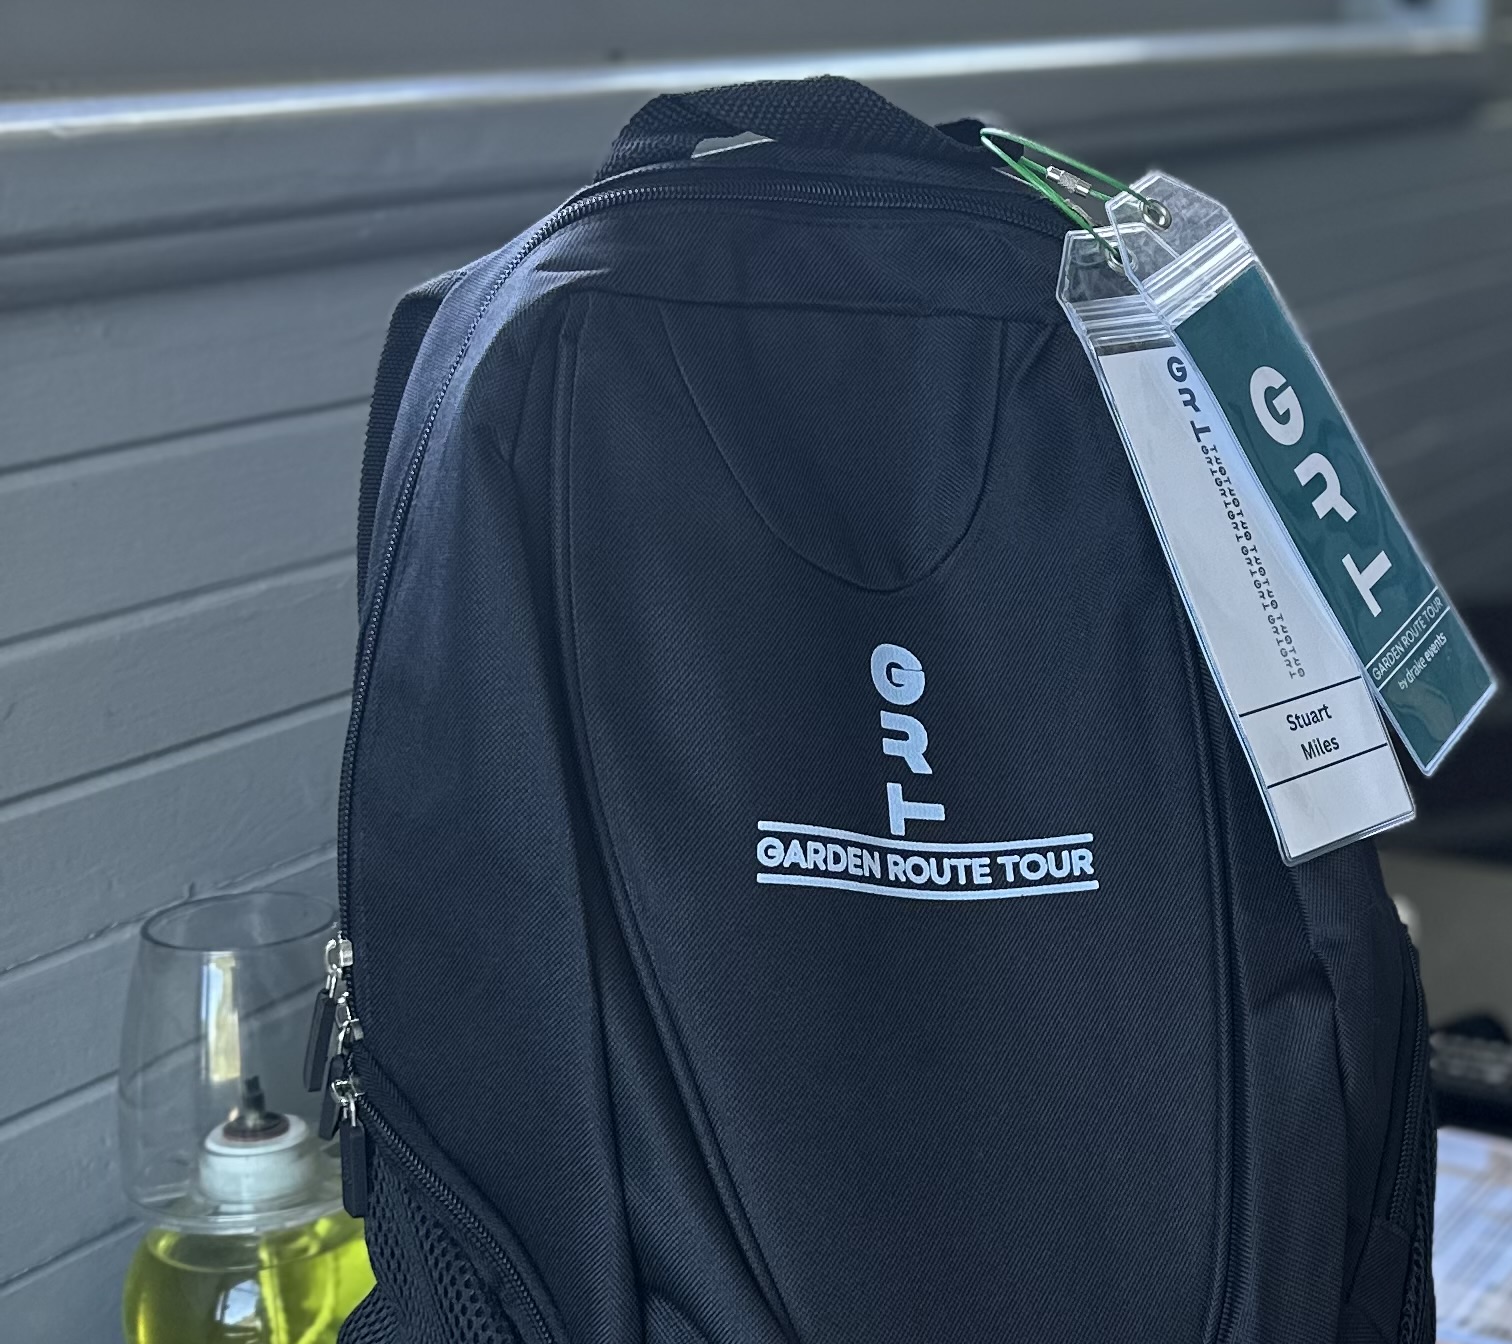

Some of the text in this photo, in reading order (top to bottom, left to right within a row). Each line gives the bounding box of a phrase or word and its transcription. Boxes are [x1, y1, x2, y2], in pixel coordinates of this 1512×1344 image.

[1372, 596, 1444, 681] GARDEN ROUTE TOUR
[1398, 632, 1447, 690] by drake events
[1286, 704, 1333, 731] Stuart
[1300, 737, 1340, 761] Miles
[756, 837, 1094, 885] GARDEN ROUTE TOUR
